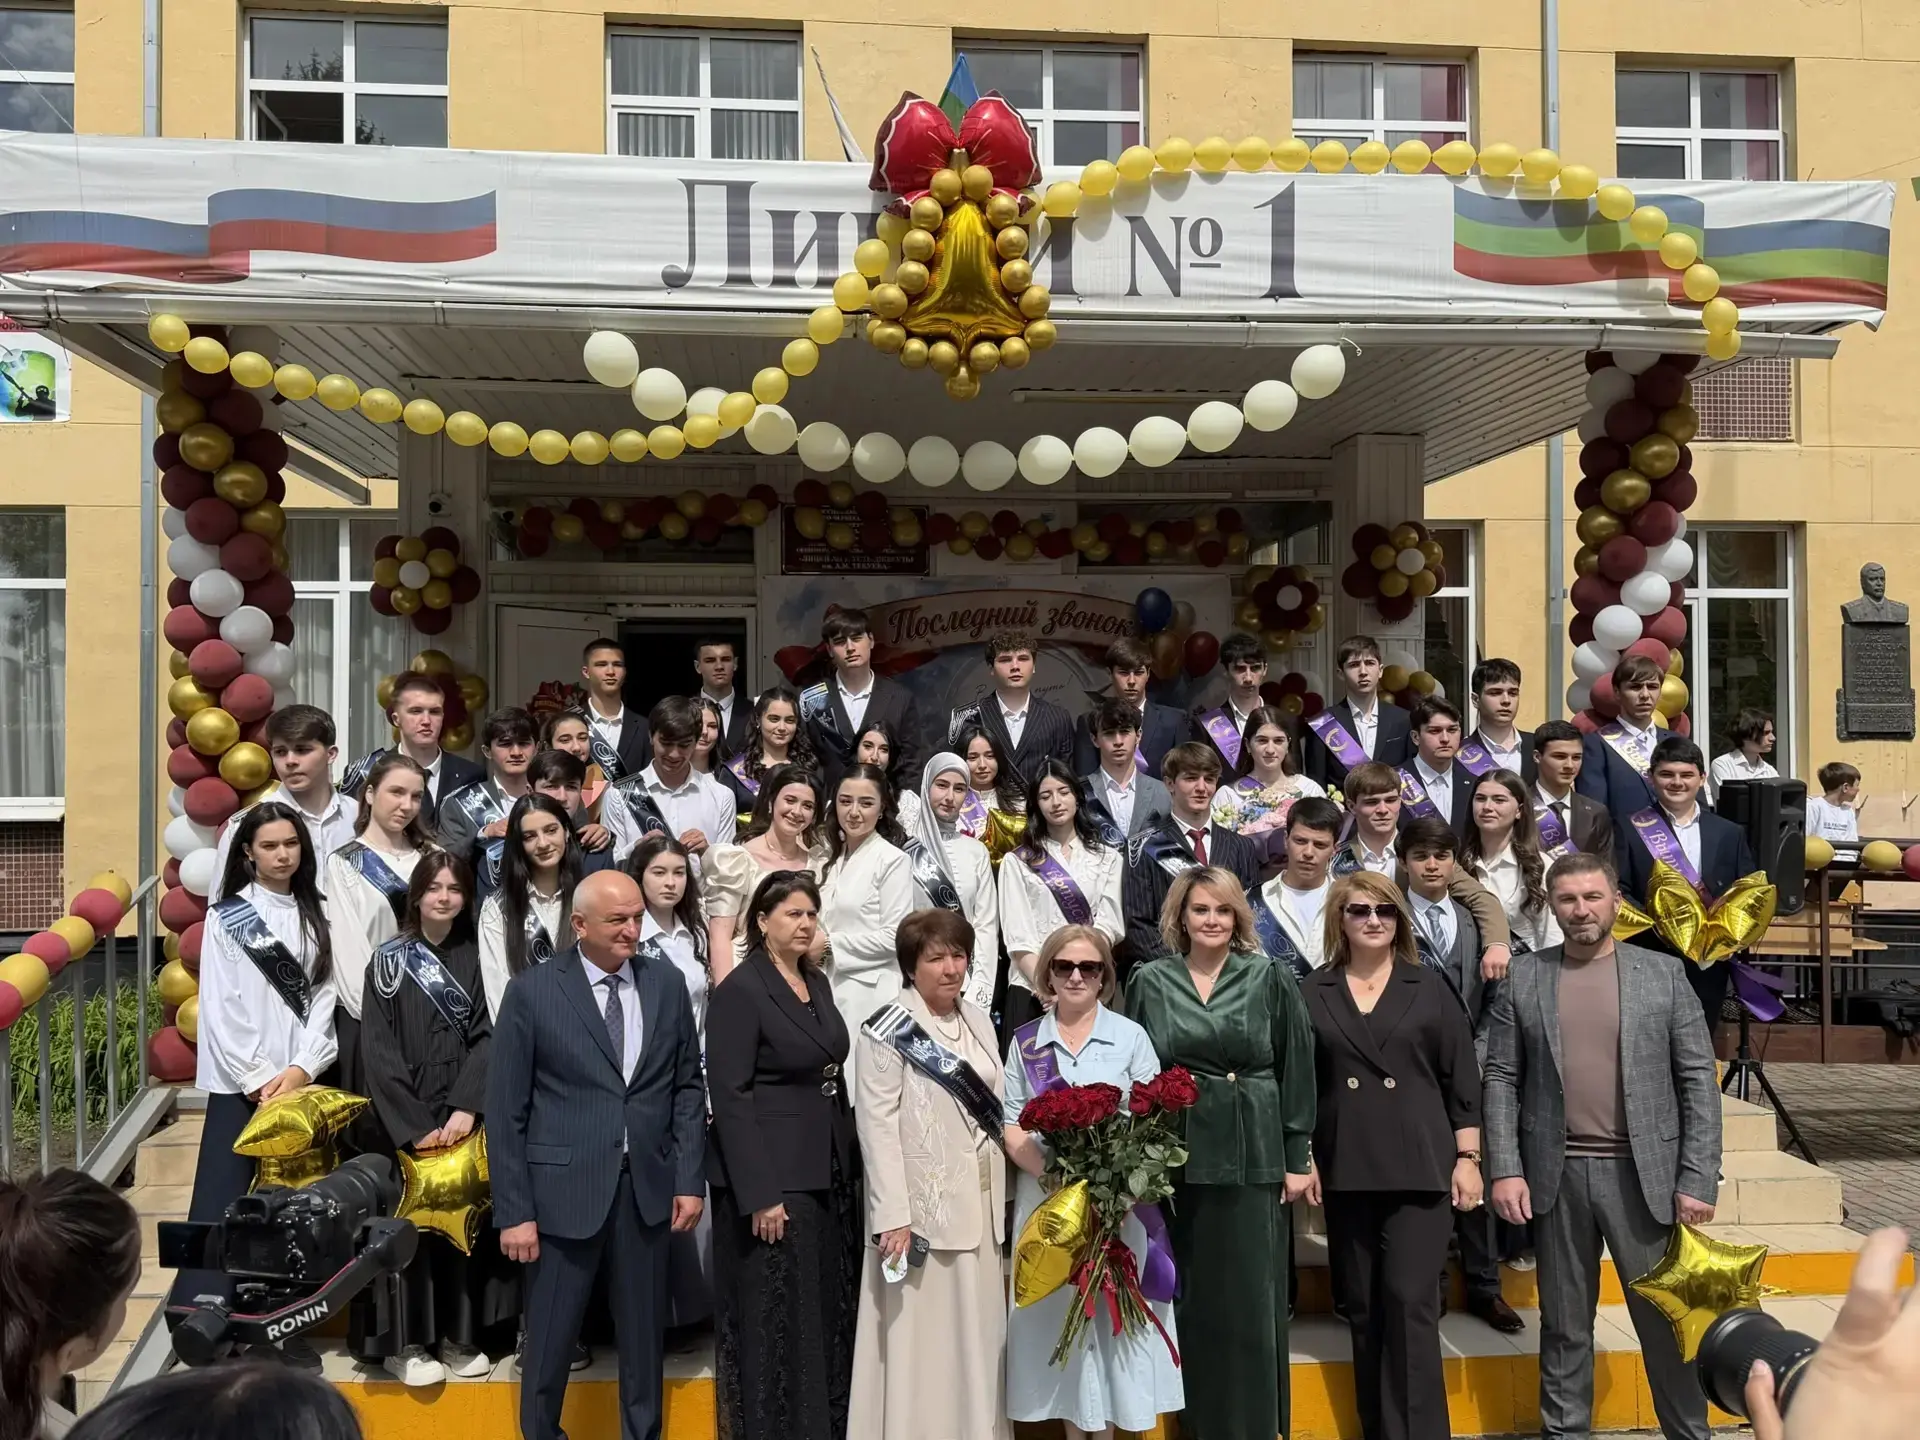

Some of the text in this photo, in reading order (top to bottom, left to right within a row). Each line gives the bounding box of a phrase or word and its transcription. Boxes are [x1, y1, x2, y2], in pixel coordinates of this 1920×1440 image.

[1124, 216, 1224, 297] №
[1253, 180, 1304, 298] 1
[888, 600, 1137, 644] Последний звонок
[267, 1300, 329, 1340] RONIN
